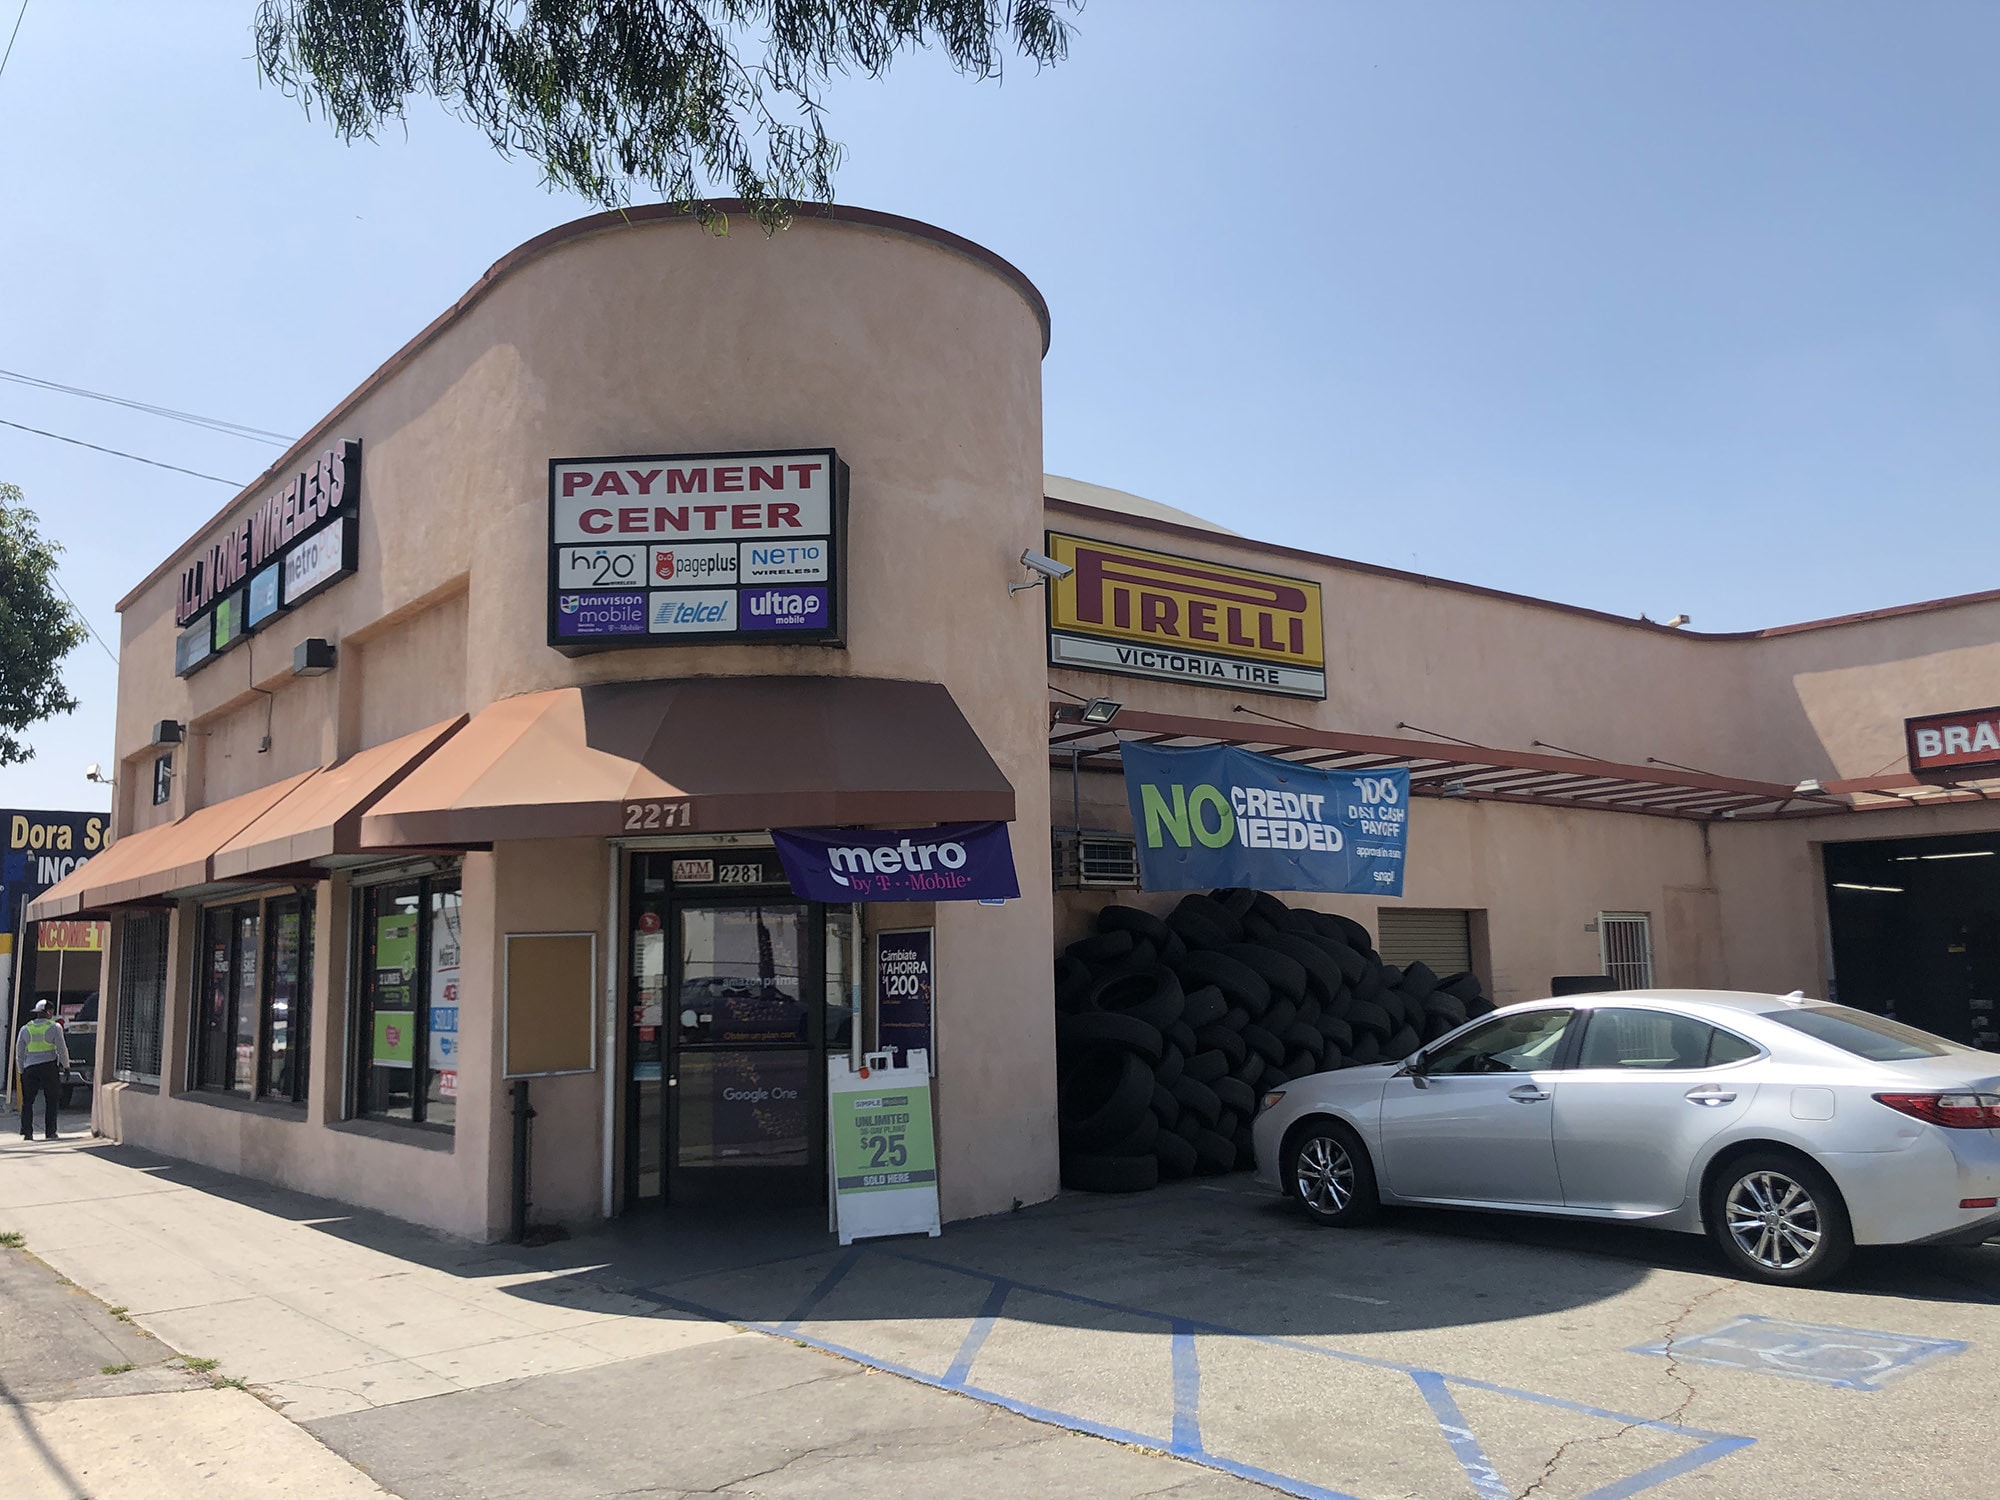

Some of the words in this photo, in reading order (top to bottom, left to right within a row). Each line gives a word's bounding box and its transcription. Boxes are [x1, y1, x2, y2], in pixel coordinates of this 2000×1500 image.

[562, 464, 822, 497] PAYMENT
[578, 502, 803, 534] CENTER
[176, 558, 200, 628] ALL
[200, 549, 216, 608] IN
[216, 524, 249, 594] ONE
[251, 438, 346, 569] WIRELESS
[676, 553, 736, 578] pageplus
[752, 568, 820, 576] WIRELESS
[673, 600, 728, 624] telcel
[751, 591, 803, 615] ultra
[1075, 547, 1308, 655] PIRELLI
[579, 607, 642, 622] mobile
[775, 616, 805, 625] mobile
[1116, 648, 1226, 678] VICTORIA
[1232, 664, 1280, 685] TIRE
[1916, 720, 2000, 758] BRA
[1352, 777, 1398, 805] 100
[625, 802, 691, 830] 2271
[1231, 786, 1325, 822] CREDIT
[1348, 805, 1374, 820] DAY
[1378, 806, 1405, 823] CASH
[1140, 784, 1235, 849] NO
[11, 815, 72, 850] Dora
[676, 861, 710, 874] ATM
[720, 864, 761, 883] 2281
[827, 839, 967, 887] metro
[850, 875, 872, 895] by
[886, 960, 929, 975] AHORRA
[444, 984, 457, 1001] 4G
[722, 977, 761, 988] amazon
[763, 975, 799, 989] prime
[723, 1087, 769, 1103] Google
[771, 1086, 798, 1100] One
[855, 1113, 910, 1128] UNLIMITED
[860, 1133, 907, 1168] $25
[863, 1175, 886, 1186] SOLD
[887, 1173, 910, 1184] HERE
